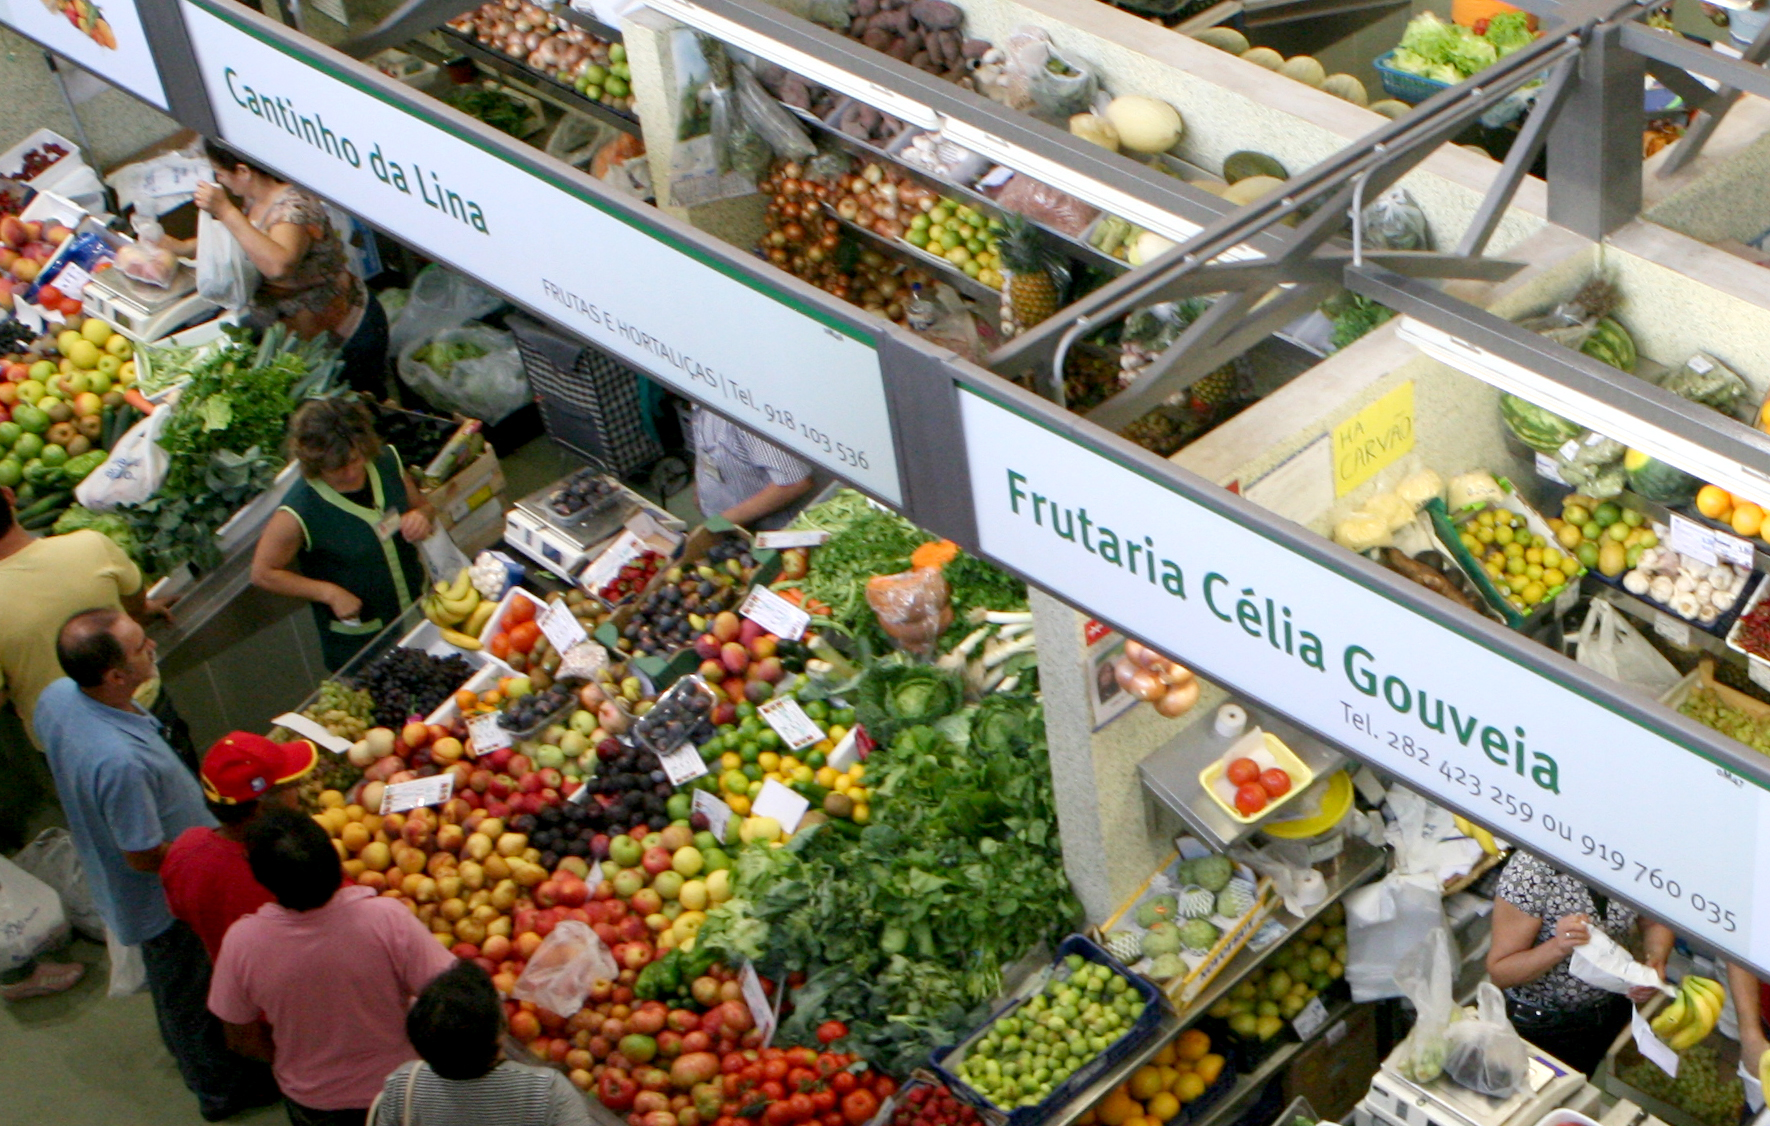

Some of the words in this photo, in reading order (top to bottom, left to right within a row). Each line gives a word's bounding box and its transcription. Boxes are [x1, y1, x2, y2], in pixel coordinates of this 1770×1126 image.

[224, 66, 362, 170] Cantinho
[368, 142, 412, 196] da
[412, 163, 491, 236] Lina
[542, 278, 601, 324] FRUTAS
[603, 311, 615, 332] E
[617, 319, 718, 388] HORTALIÇAS
[727, 379, 761, 412] Tel.
[764, 403, 796, 431] 918
[800, 423, 832, 454] 103
[836, 441, 869, 470] 536
[1006, 467, 1188, 602] Frutaria
[1201, 570, 1327, 674] Célia
[1342, 643, 1562, 796] Gouveia
[1339, 700, 1380, 741] Tel.
[1387, 731, 1430, 767] 282
[1438, 760, 1482, 797] 423
[1490, 785, 1534, 823] 259
[1542, 813, 1572, 842] ou
[1581, 834, 1626, 872] 919
[1633, 860, 1682, 899] 760
[1690, 892, 1737, 933] 035
